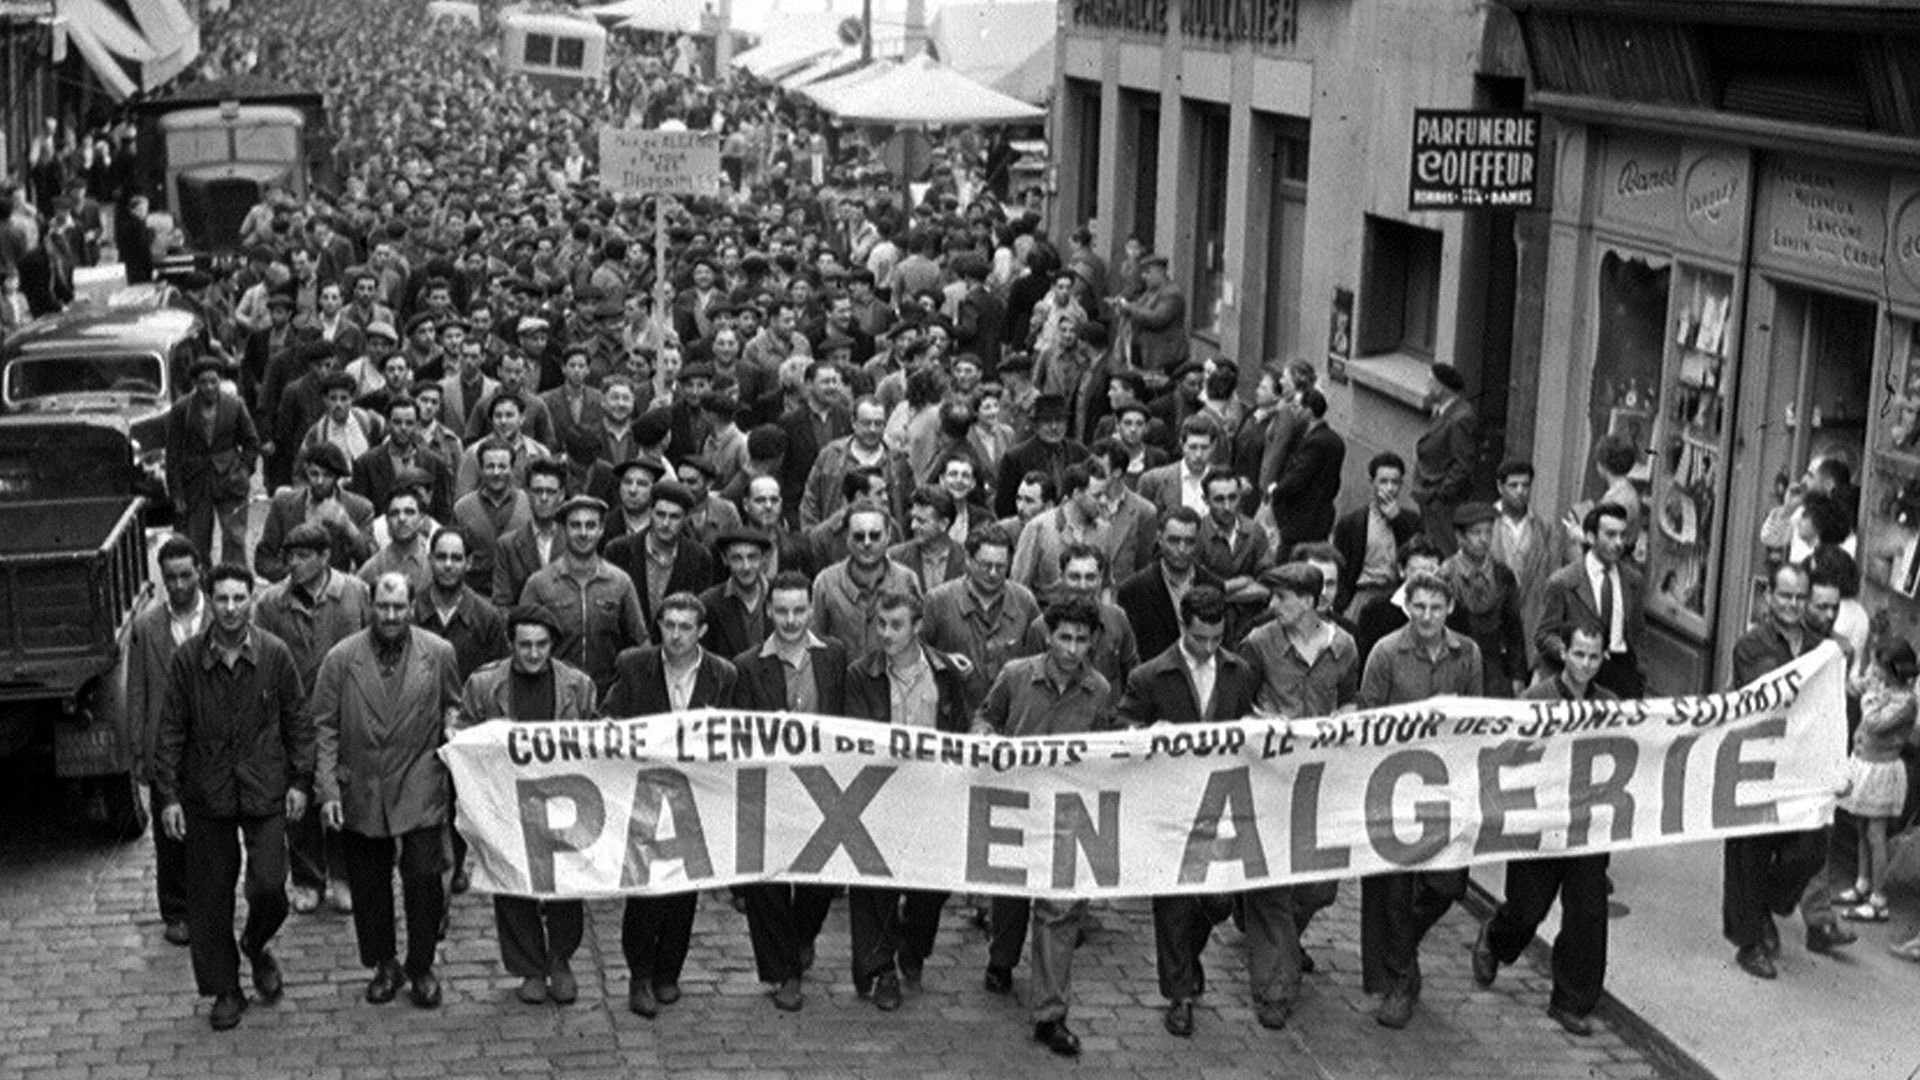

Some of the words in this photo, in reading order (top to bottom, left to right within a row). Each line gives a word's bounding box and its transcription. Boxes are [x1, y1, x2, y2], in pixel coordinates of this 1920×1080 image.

[1417, 117, 1535, 147] PARFUMERIE
[1418, 149, 1534, 187] COIFFEUR
[508, 719, 649, 766] CONTRE
[676, 716, 821, 763] L'ENVOI
[834, 736, 875, 755] DE
[1453, 716, 1514, 736] DES
[515, 764, 899, 894] PAIX
[965, 785, 1121, 890] EN
